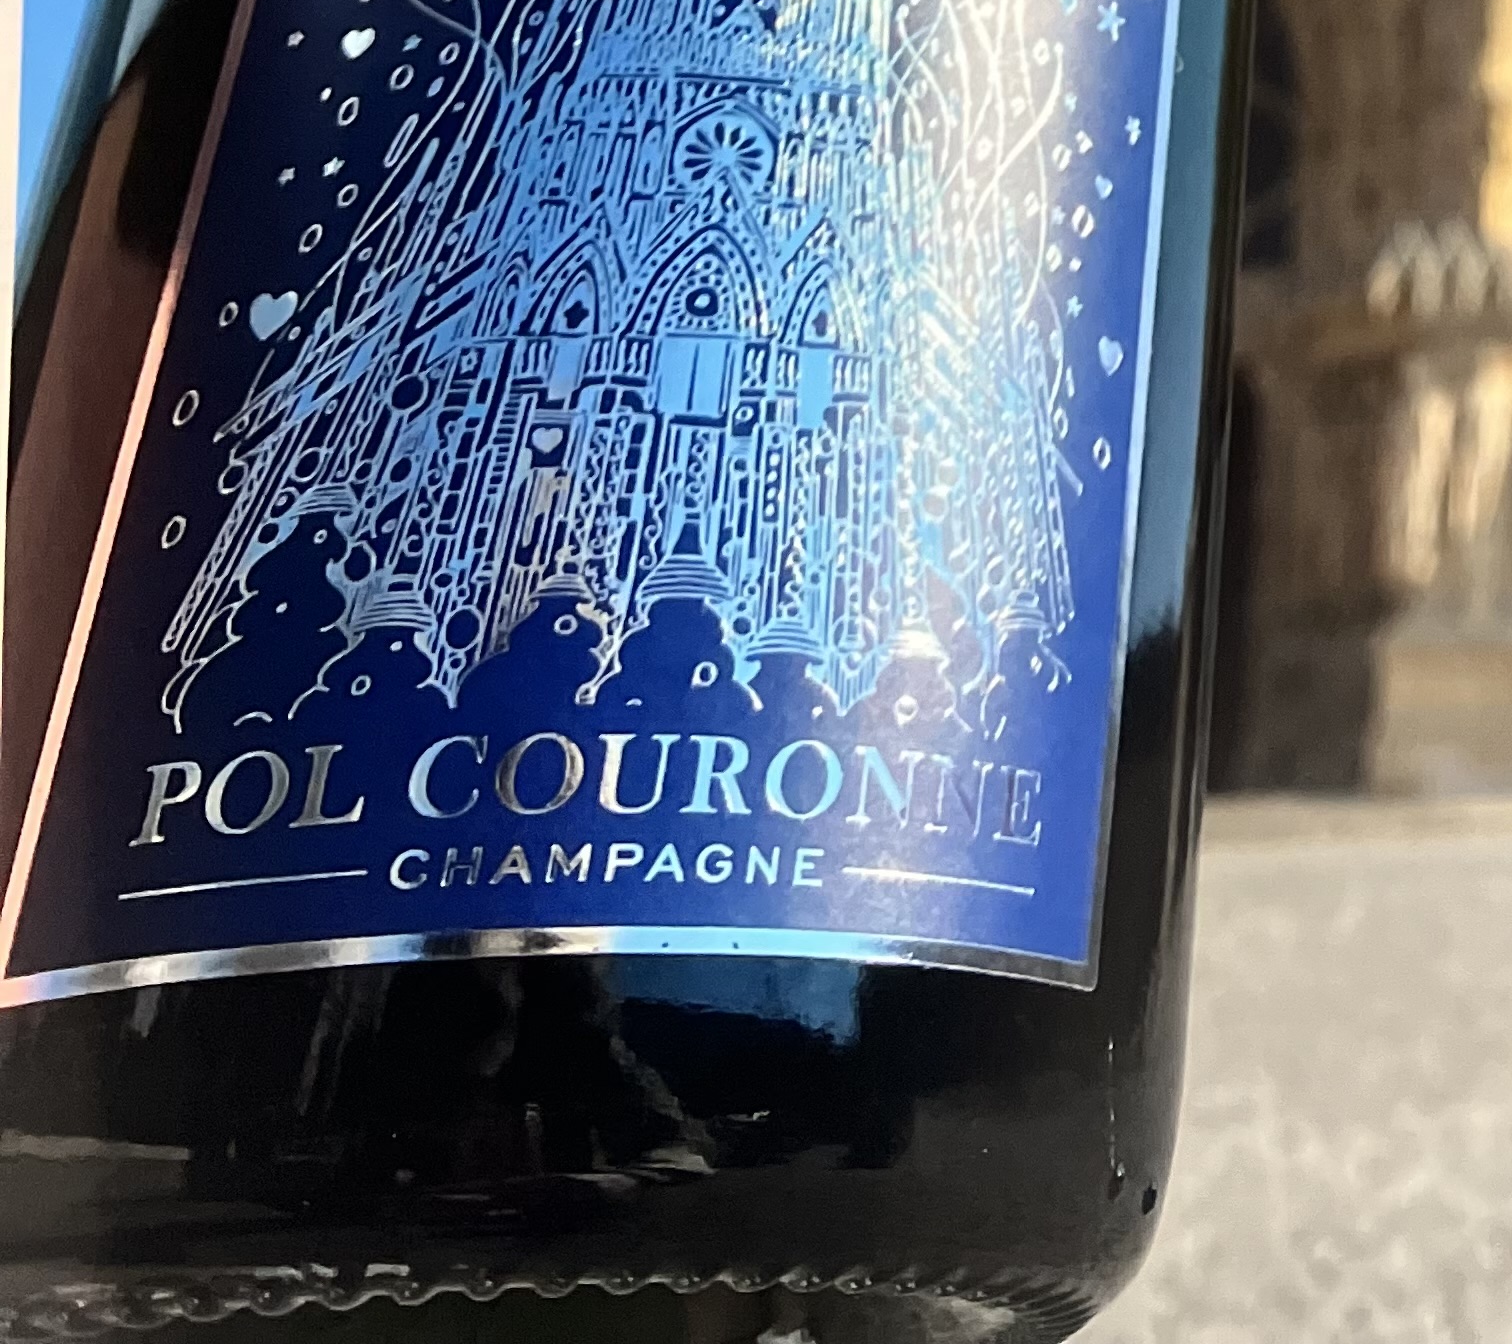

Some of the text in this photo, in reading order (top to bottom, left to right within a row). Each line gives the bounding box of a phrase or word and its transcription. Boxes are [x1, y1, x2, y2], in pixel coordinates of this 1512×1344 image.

[129, 732, 1042, 847] POL COURONNE
[389, 842, 826, 889] CHAMPAGNE
